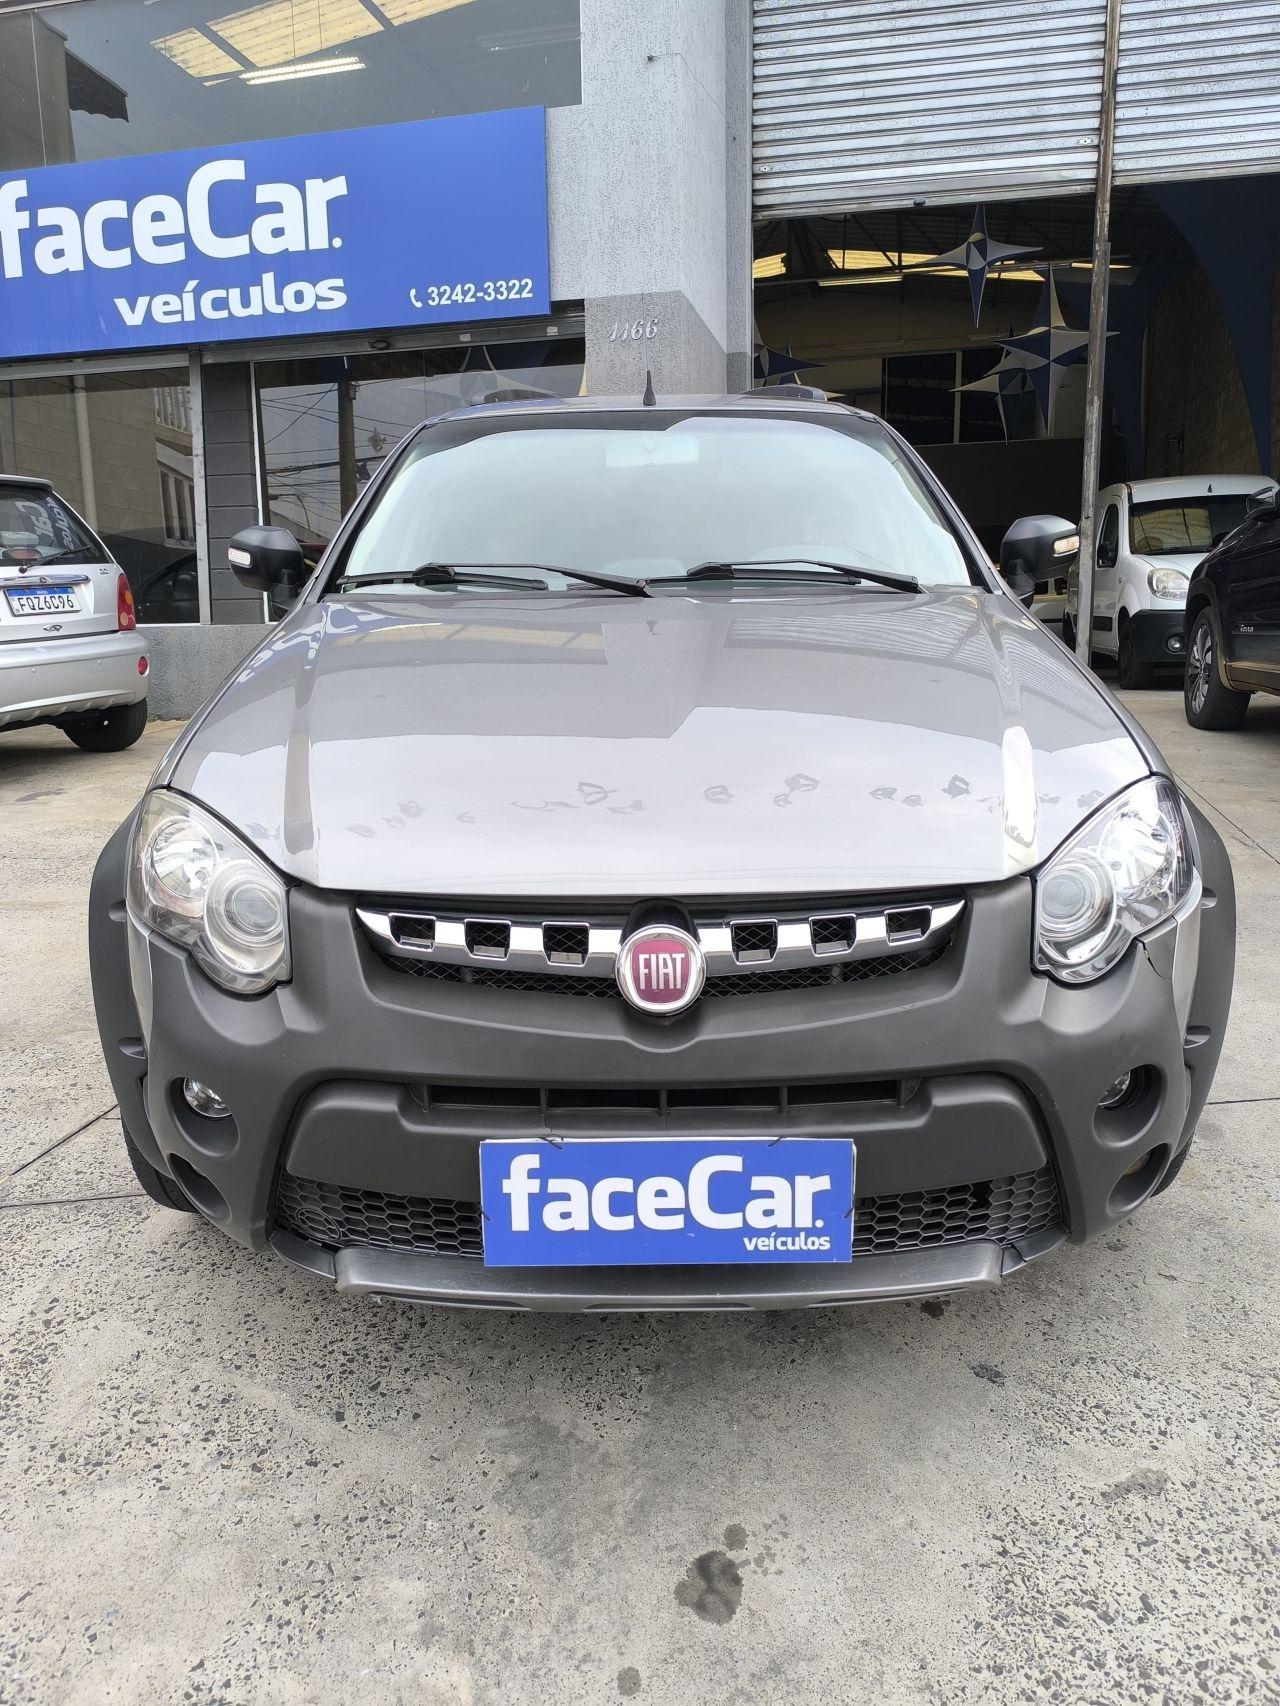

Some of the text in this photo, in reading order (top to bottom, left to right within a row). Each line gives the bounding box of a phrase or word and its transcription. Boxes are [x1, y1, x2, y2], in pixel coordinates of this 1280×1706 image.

[114, 272, 348, 326] veículos
[427, 278, 533, 306] 3242-3322
[607, 318, 659, 342] 1166
[17, 594, 75, 612] FQZ6C96
[637, 951, 686, 991] FIAT
[743, 1231, 831, 1251] veículos
